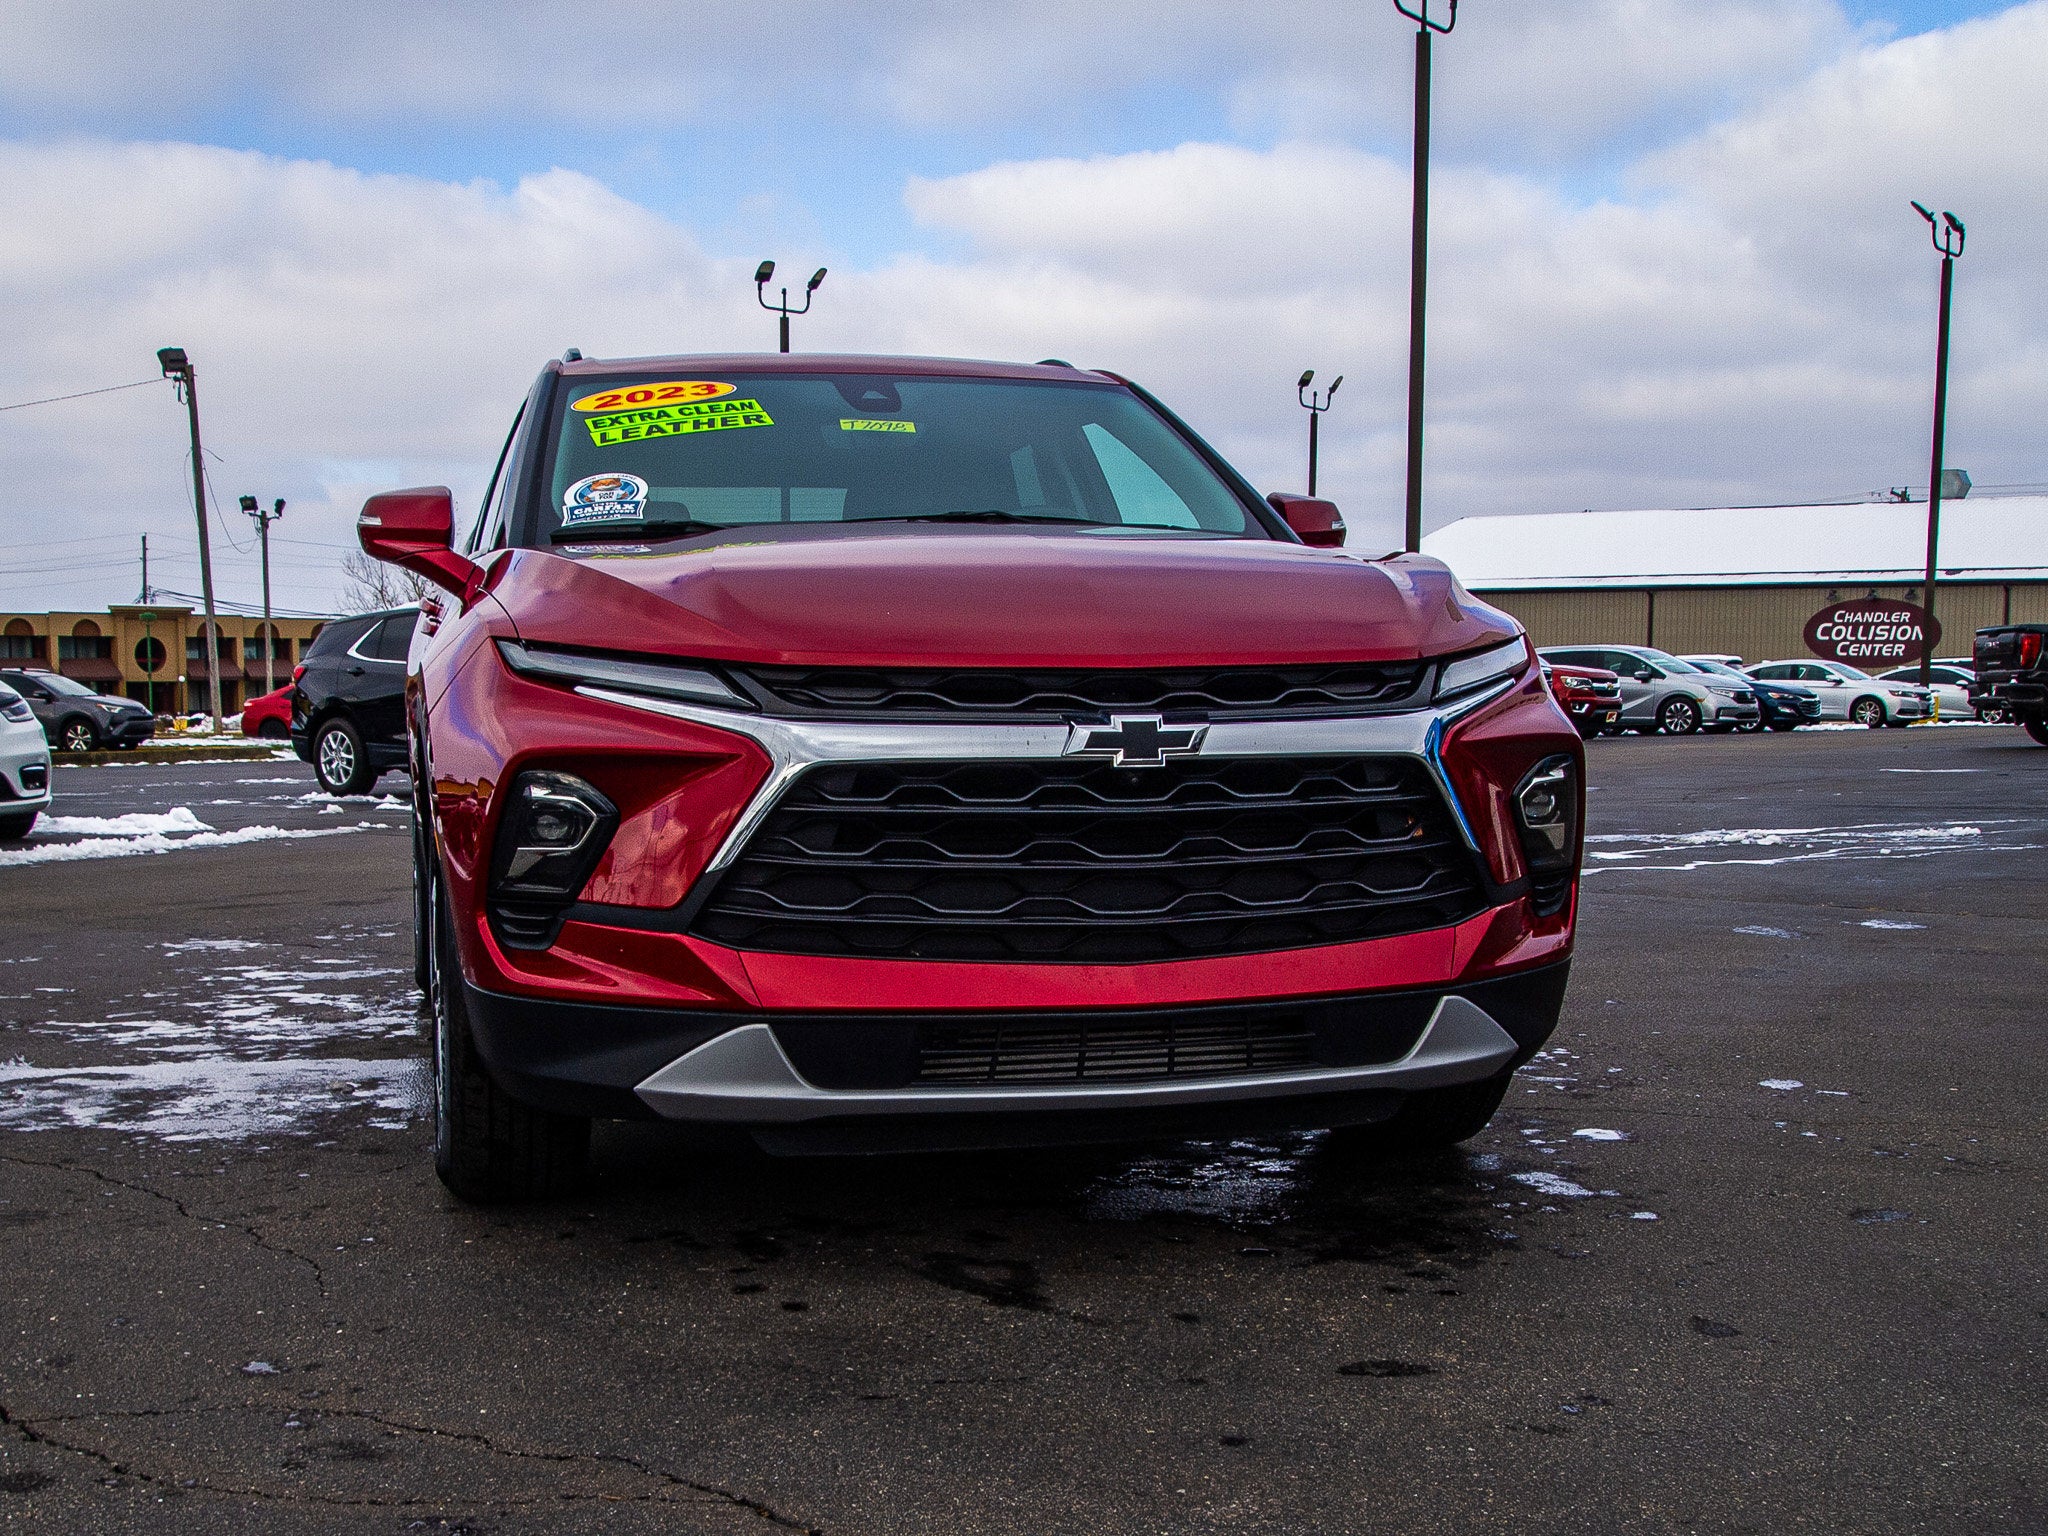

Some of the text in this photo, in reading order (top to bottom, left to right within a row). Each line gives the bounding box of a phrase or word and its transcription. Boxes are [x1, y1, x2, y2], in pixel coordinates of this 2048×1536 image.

[593, 383, 719, 410] 2023
[591, 400, 755, 429] EXTRA CLEAN
[599, 413, 770, 445] LEATHER
[573, 503, 636, 515] CARFAX
[1833, 610, 1911, 623] CHANDLER
[1815, 623, 1923, 641] COLLISION
[1836, 641, 1906, 656] CENTER
